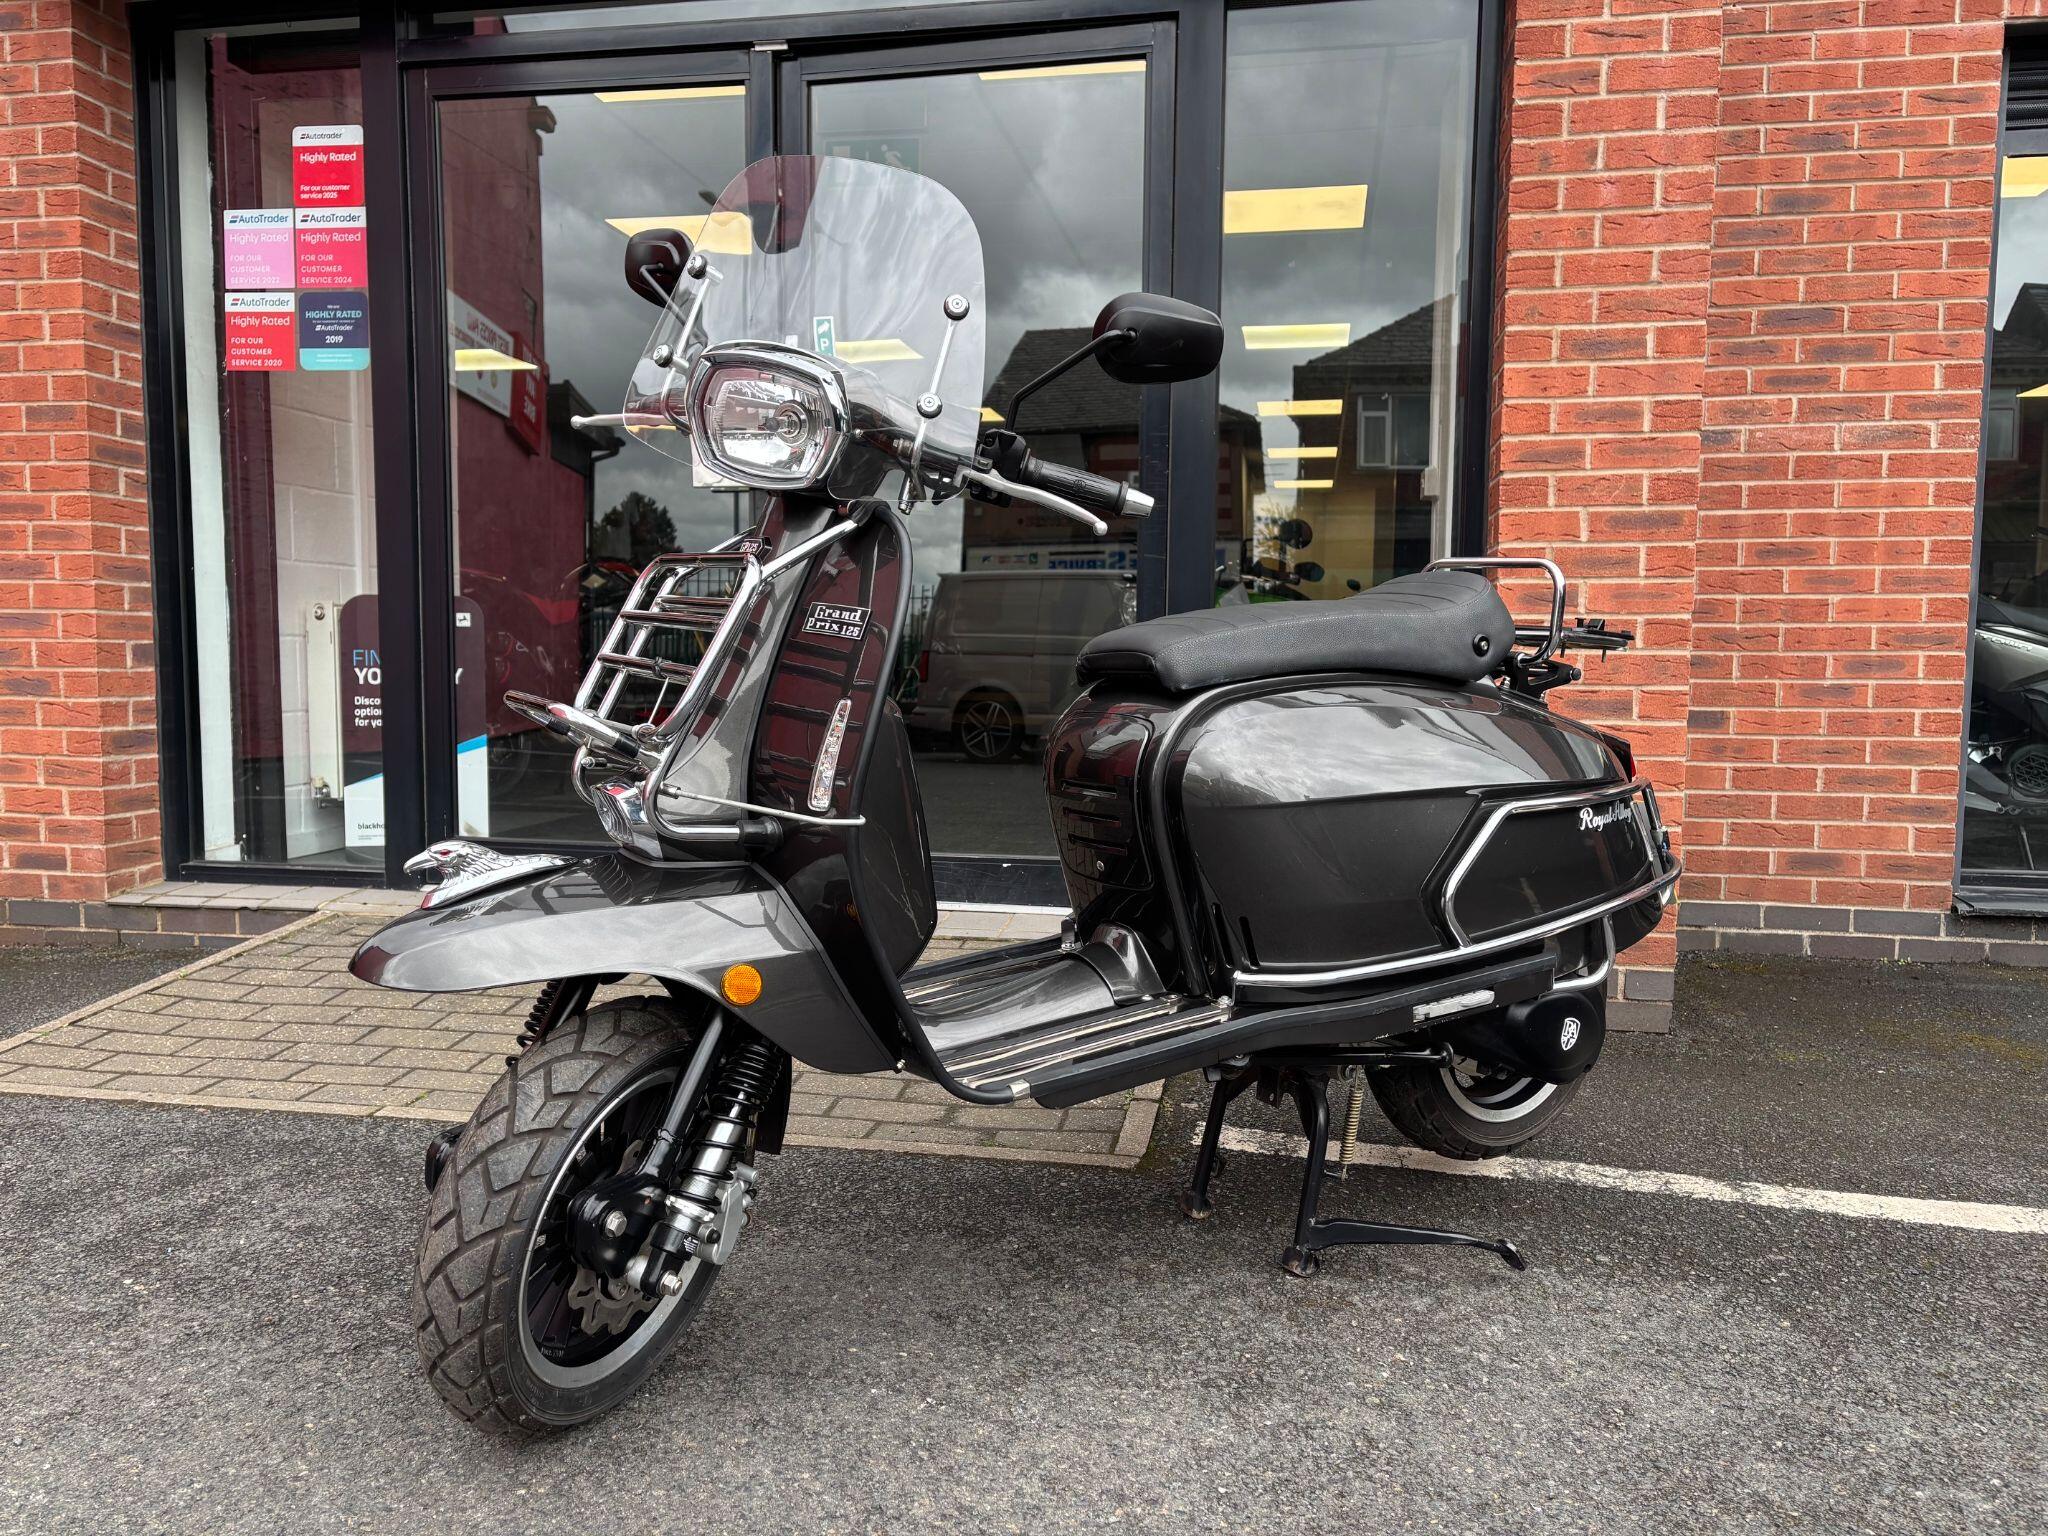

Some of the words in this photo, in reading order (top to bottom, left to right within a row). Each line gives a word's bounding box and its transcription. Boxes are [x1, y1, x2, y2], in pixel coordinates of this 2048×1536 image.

[305, 132, 342, 140] Autotrader
[300, 152, 328, 164] Highly
[329, 151, 357, 161] Rated
[238, 213, 289, 223] AutoTrader
[309, 213, 361, 223] AutoTrader
[230, 233, 259, 245] Highly
[261, 232, 289, 242] Rated
[301, 232, 331, 244] Highly
[332, 231, 362, 242] Rated
[301, 265, 342, 273] CUSTOMER
[301, 276, 332, 284] SERVICE
[239, 297, 290, 307] AutoTrader
[305, 310, 336, 319] HIGHLY
[336, 310, 362, 318] RATED
[230, 316, 260, 328] Highly
[261, 316, 290, 326] Rated
[325, 335, 344, 344] 2019
[231, 359, 262, 367] SERVICE
[814, 605, 862, 621] Grand
[806, 617, 840, 632] Prix
[841, 625, 860, 636] 125
[354, 696, 381, 705] Disco
[355, 718, 369, 727] for
[1580, 807, 1613, 831] Royal
